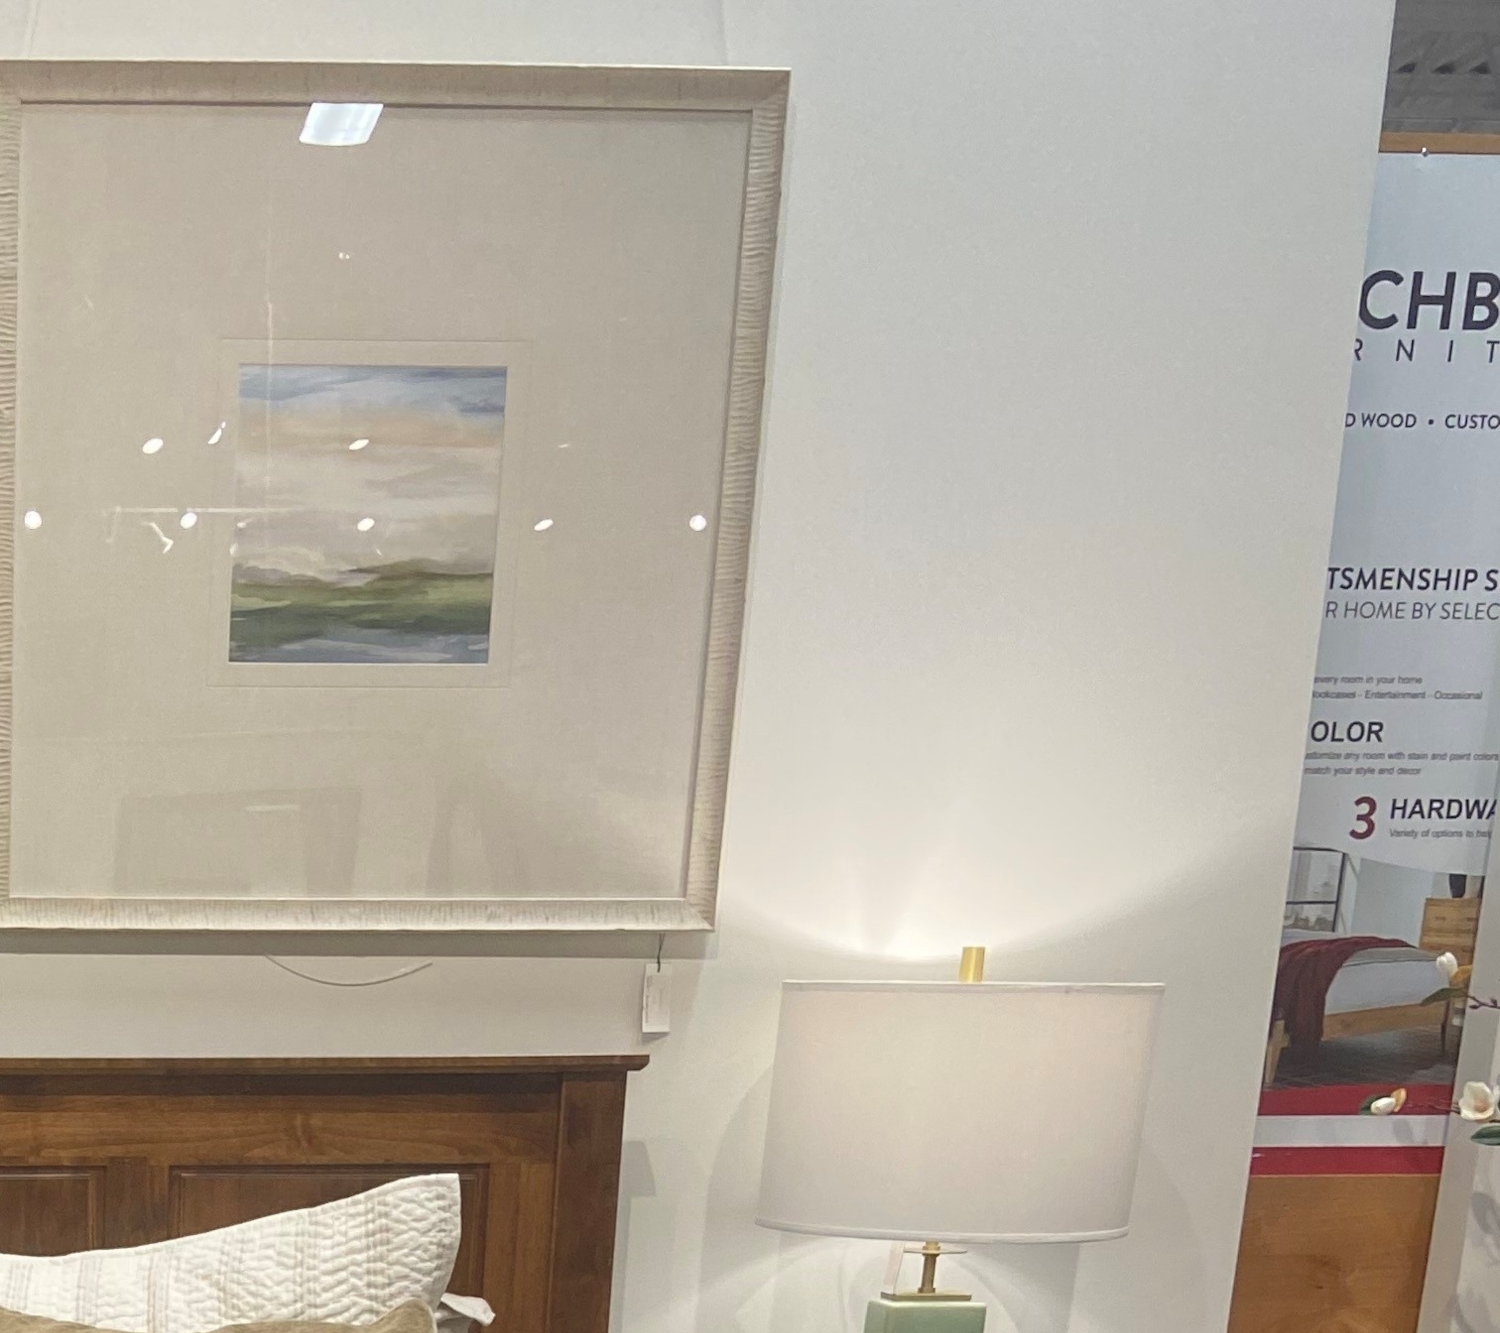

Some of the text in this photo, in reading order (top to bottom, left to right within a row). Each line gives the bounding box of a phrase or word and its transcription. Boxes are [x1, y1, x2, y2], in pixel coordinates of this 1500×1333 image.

[1359, 269, 1500, 331] CHB
[1361, 412, 1417, 428] WOOD
[1328, 566, 1499, 591] TSMENSHIP S
[1325, 601, 1500, 621] R HOME BY SELEC
[1310, 720, 1384, 743] OLOR
[1349, 796, 1377, 840] 3
